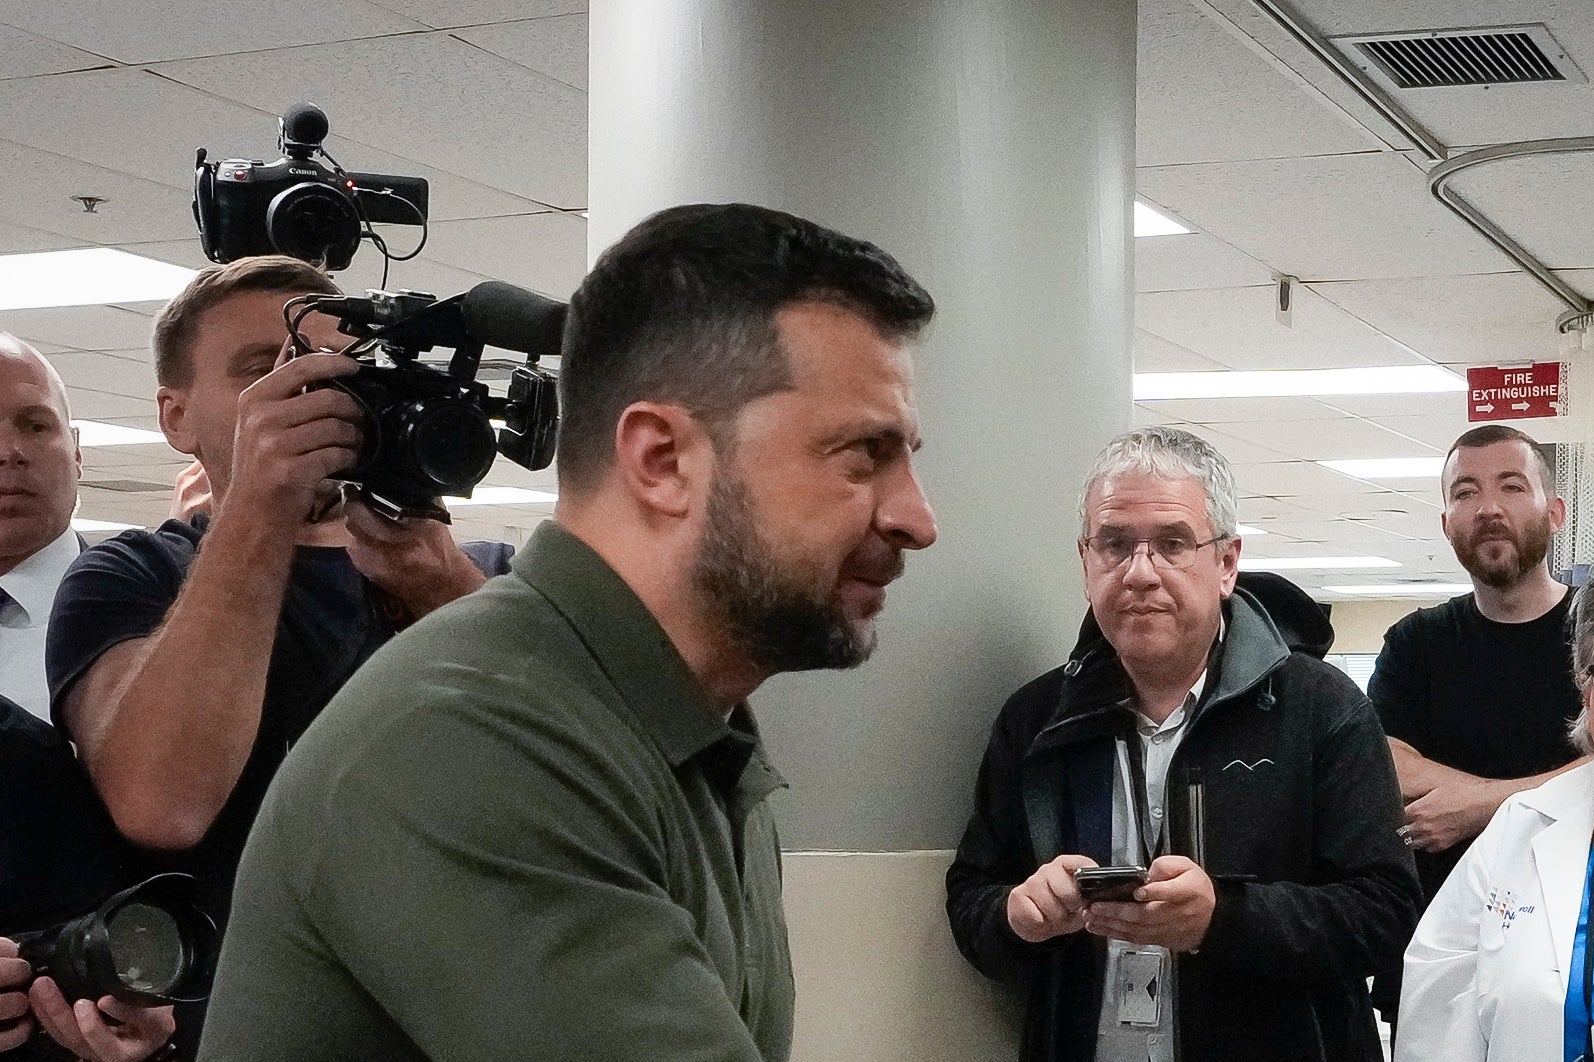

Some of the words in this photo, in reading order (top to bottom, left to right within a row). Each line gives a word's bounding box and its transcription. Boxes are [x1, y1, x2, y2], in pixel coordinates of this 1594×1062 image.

[288, 167, 318, 176] Canon
[1504, 372, 1533, 386] FIRE
[1472, 384, 1562, 401] EXTINGUISHE
